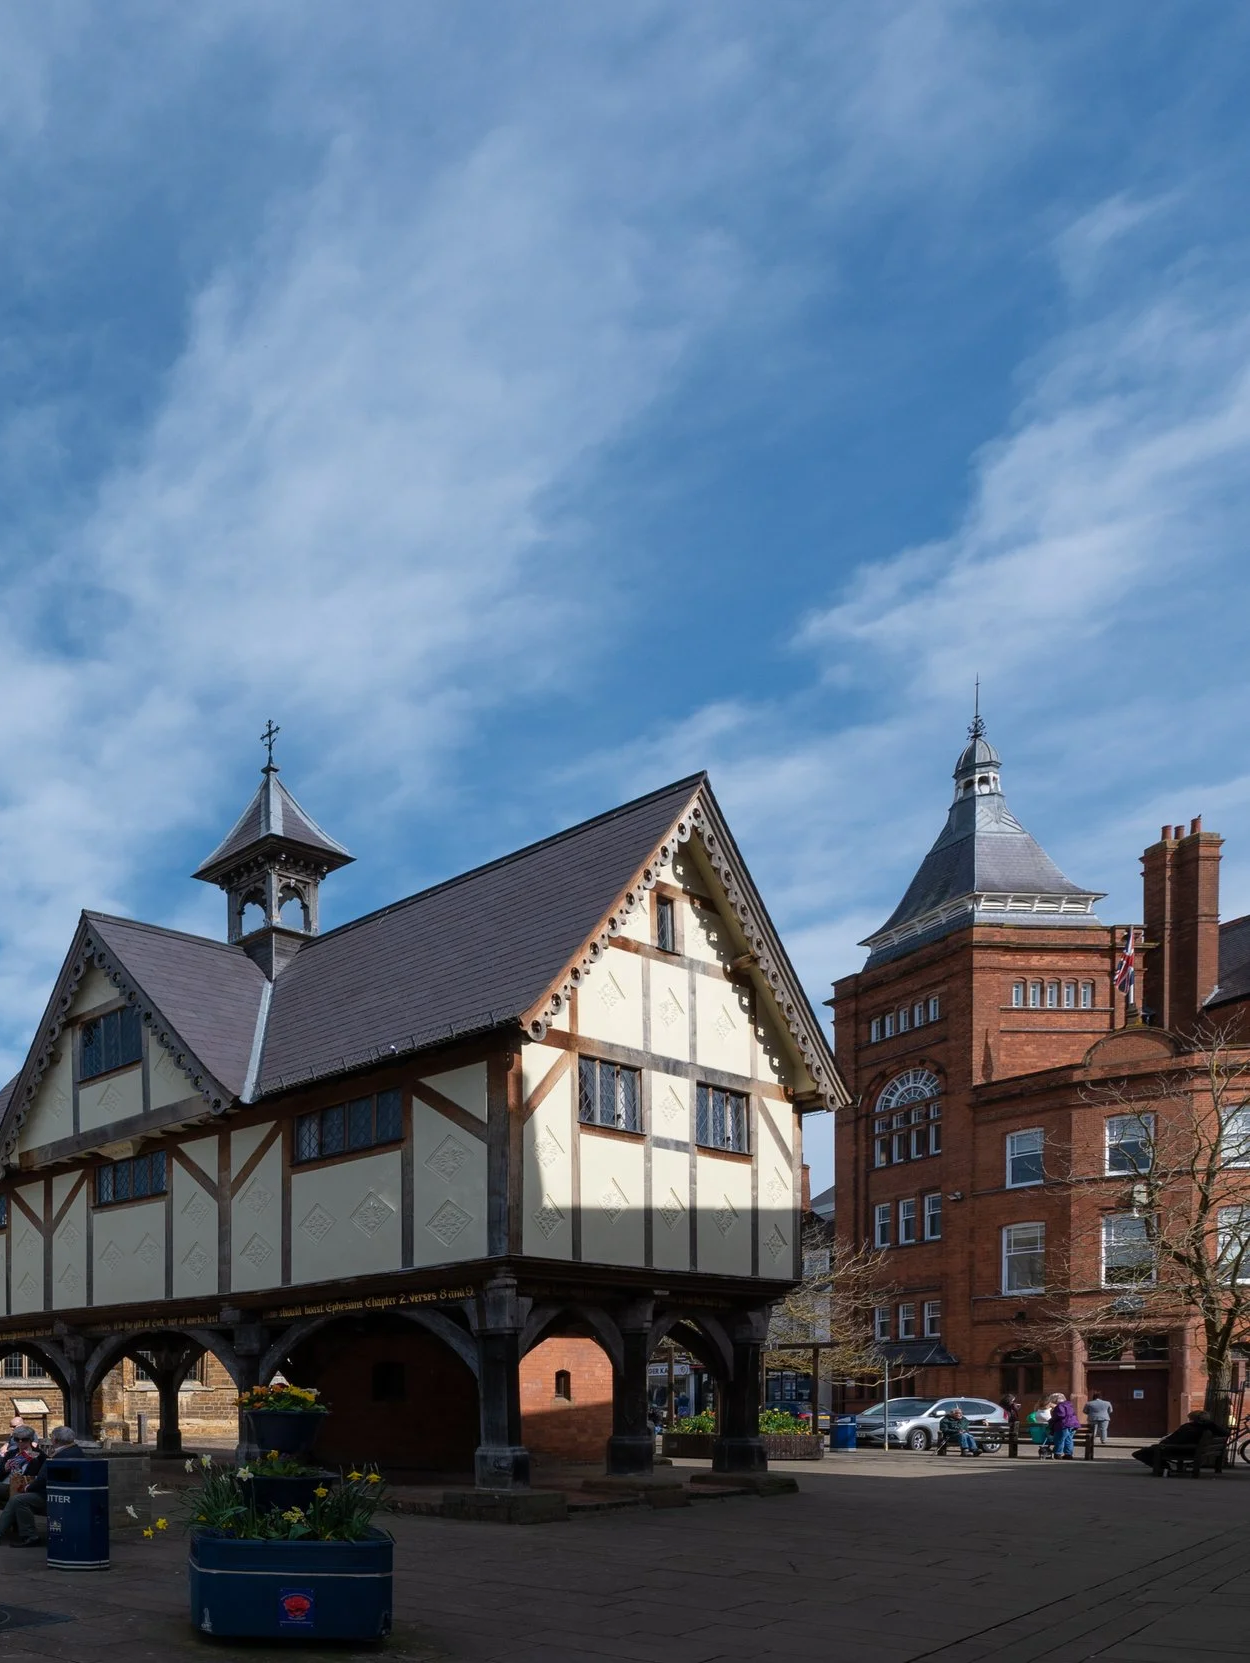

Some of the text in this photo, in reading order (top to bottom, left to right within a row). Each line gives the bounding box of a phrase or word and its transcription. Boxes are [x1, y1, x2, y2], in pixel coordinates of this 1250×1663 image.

[325, 1300, 363, 1314] Ephesians
[364, 1295, 397, 1309] Chapter
[410, 1292, 437, 1303] verses
[439, 1288, 447, 1299] 8
[448, 1287, 465, 1299] and
[46, 1494, 71, 1504] ITTER
